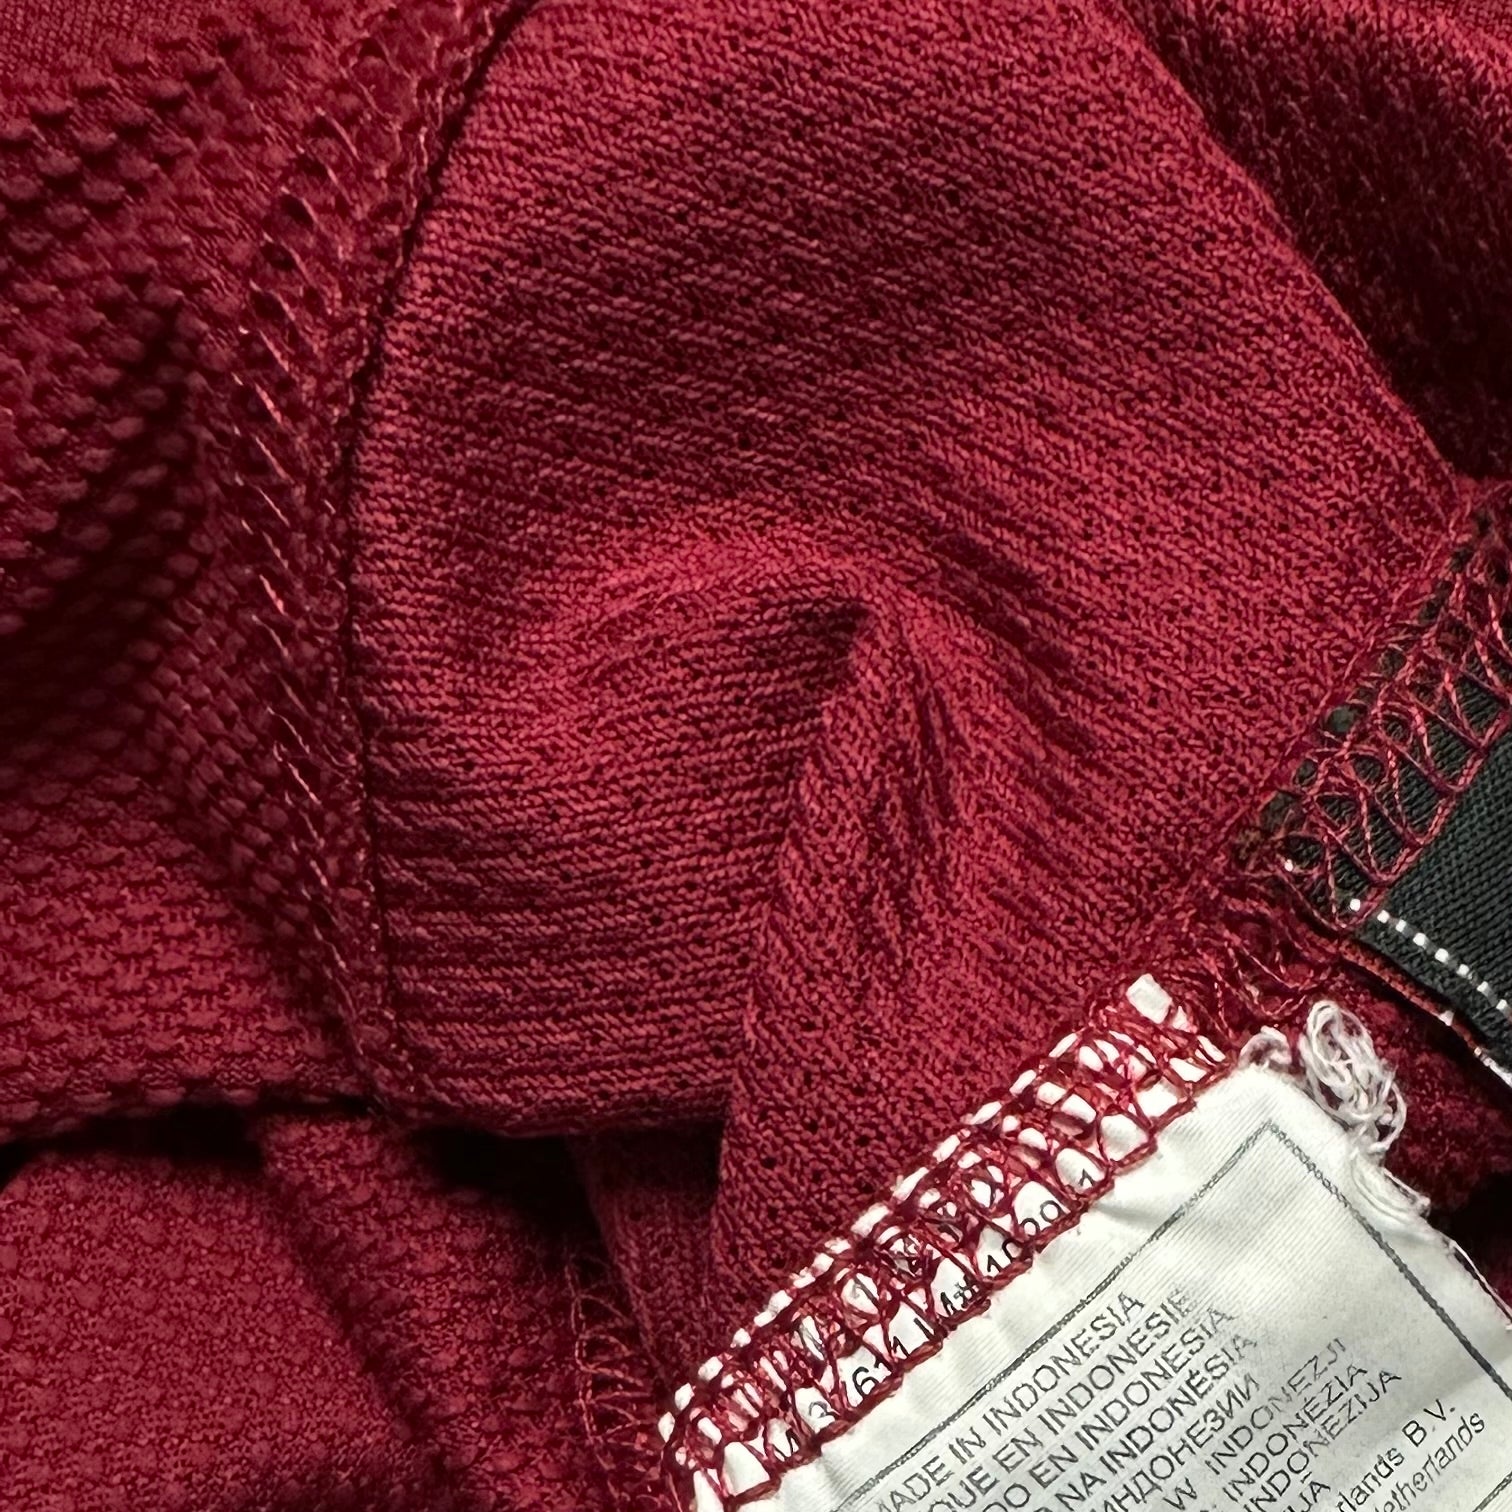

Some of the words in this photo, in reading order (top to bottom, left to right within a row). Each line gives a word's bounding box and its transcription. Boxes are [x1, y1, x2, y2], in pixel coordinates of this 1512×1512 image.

[948, 1427, 986, 1464] IN
[982, 1292, 1145, 1436] INDONESIA
[992, 1428, 1044, 1473] EN
[1037, 1289, 1191, 1435] INDONESIE
[1028, 1445, 1078, 1489] EN
[1074, 1308, 1234, 1451] INDONESIA
[1054, 1472, 1107, 1512] NA
[1099, 1335, 1252, 1475] INDONÉSIA
[1162, 1477, 1197, 1511] W
[1204, 1338, 1346, 1476] INDONEZJI
[1222, 1365, 1368, 1502] INDONÉZIA
[1402, 1398, 1456, 1448] B.V.
